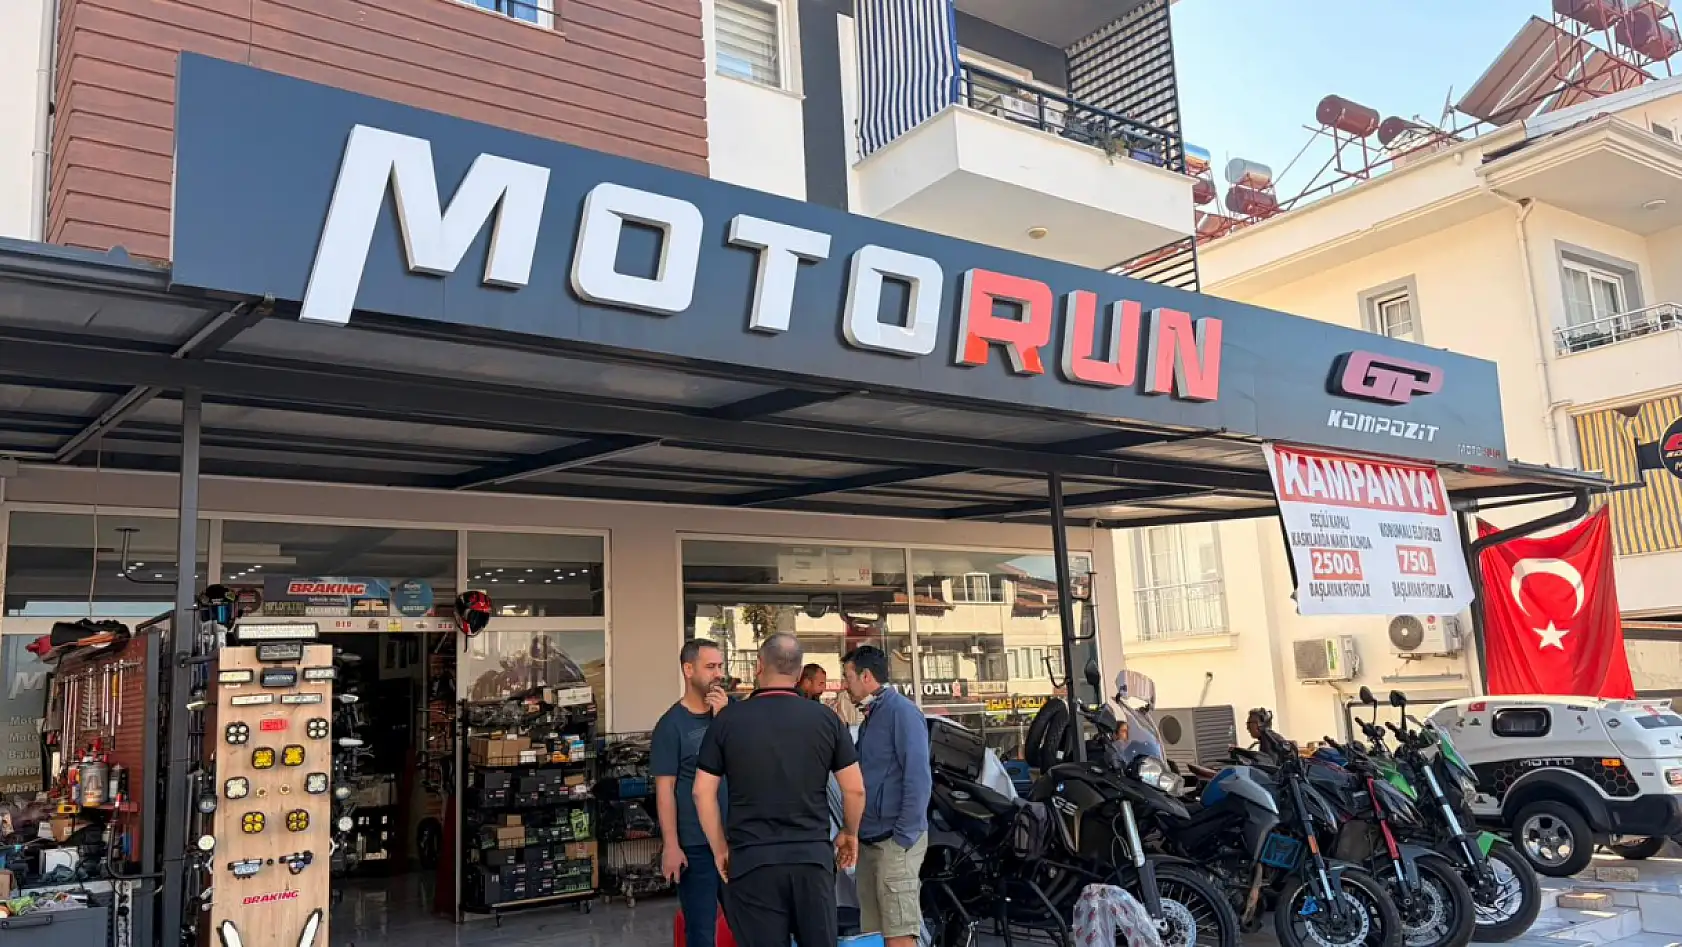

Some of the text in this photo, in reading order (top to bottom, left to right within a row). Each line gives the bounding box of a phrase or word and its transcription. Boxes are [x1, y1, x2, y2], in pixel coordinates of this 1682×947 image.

[300, 124, 1222, 402] MOTORUN
[1279, 450, 1438, 511] KAMPANYA
[288, 583, 366, 595] BRAKING
[1519, 757, 1575, 767] MOTTO
[242, 890, 300, 905] BRAKING
